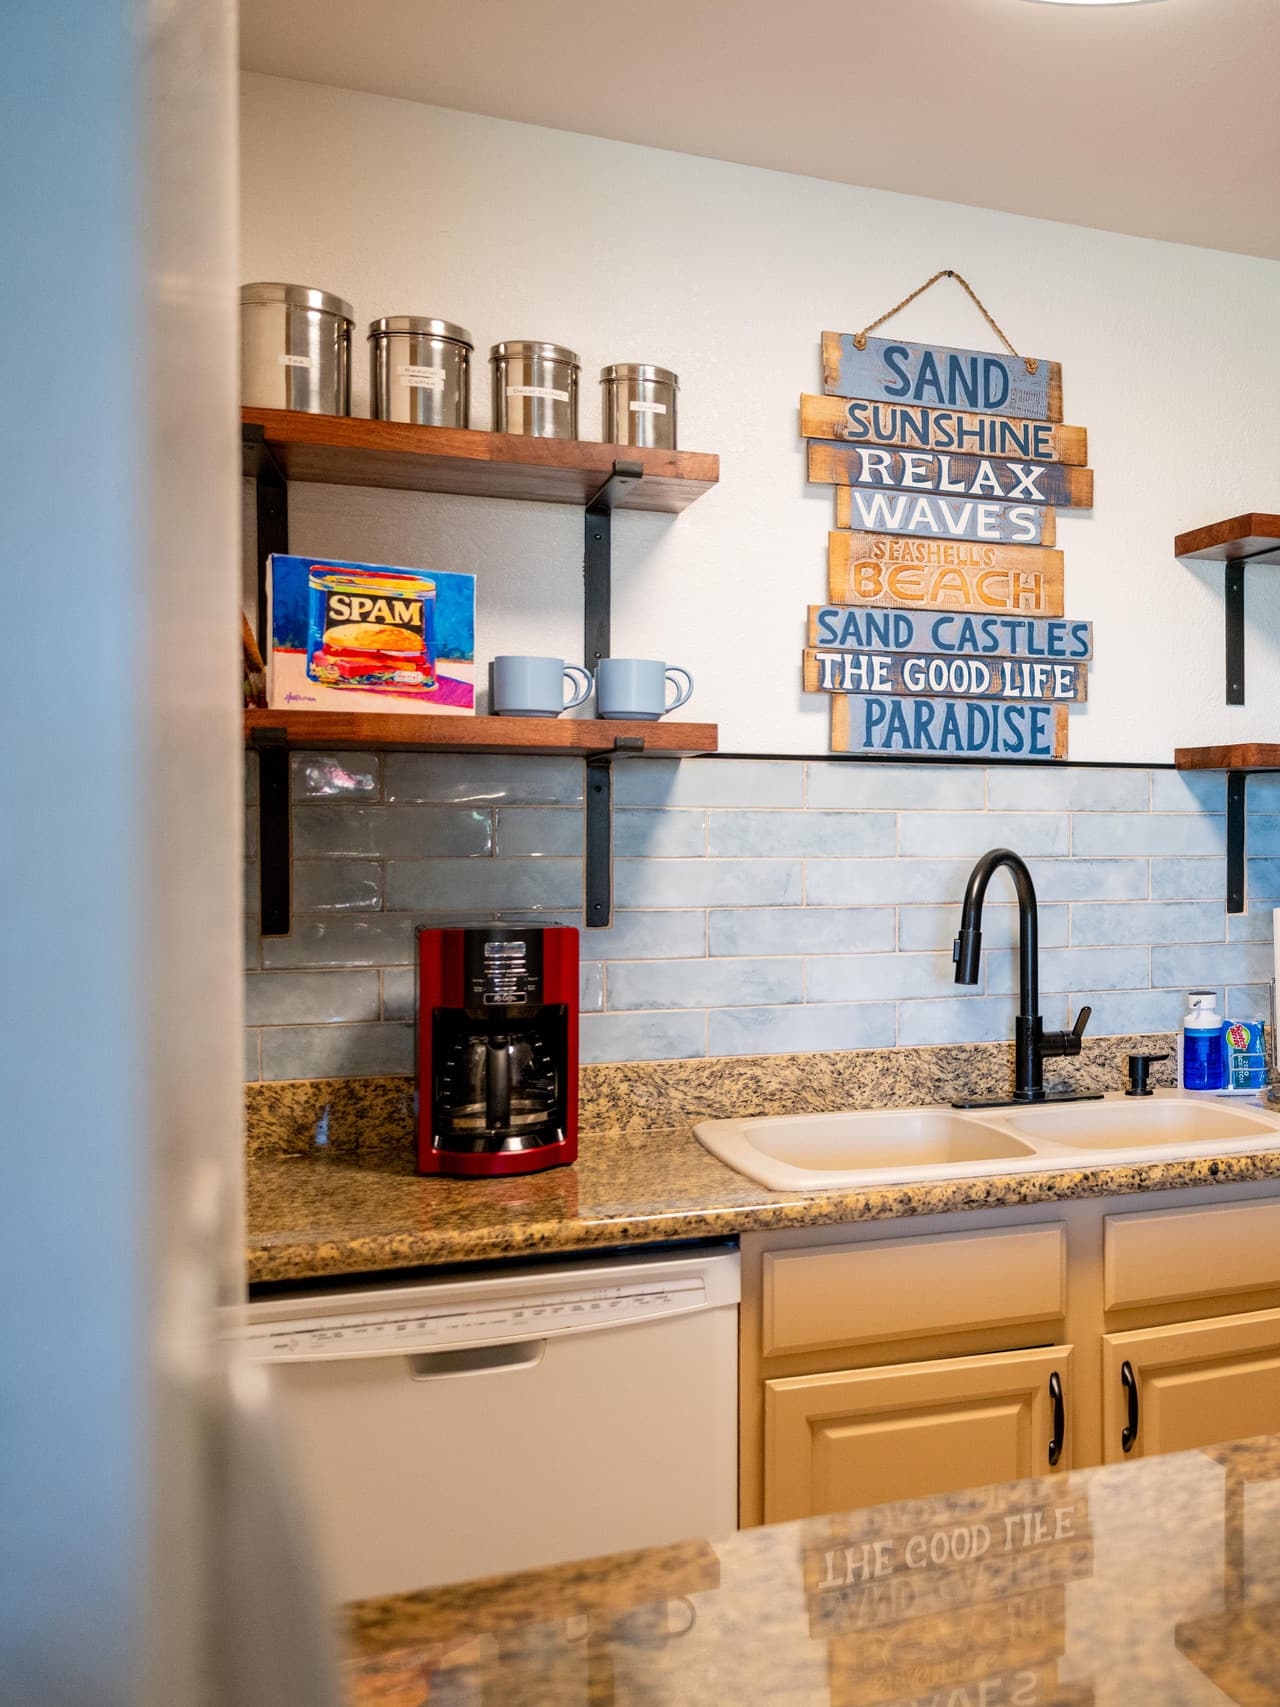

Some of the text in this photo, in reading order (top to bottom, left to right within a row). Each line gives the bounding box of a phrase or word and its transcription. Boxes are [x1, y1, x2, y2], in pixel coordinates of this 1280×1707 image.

[883, 345, 1009, 409] SAND
[847, 403, 1054, 459] SUNSHINE
[855, 448, 1048, 501] RELAX
[854, 491, 1037, 541] WAVES
[873, 539, 998, 567] SEASHELLS
[328, 594, 423, 626] SPAM
[853, 561, 1042, 610] BEACH
[817, 609, 1090, 658] SAND CASTLES
[815, 652, 1076, 698] THE GOOD LIFE
[862, 698, 1052, 756] PARADISE
